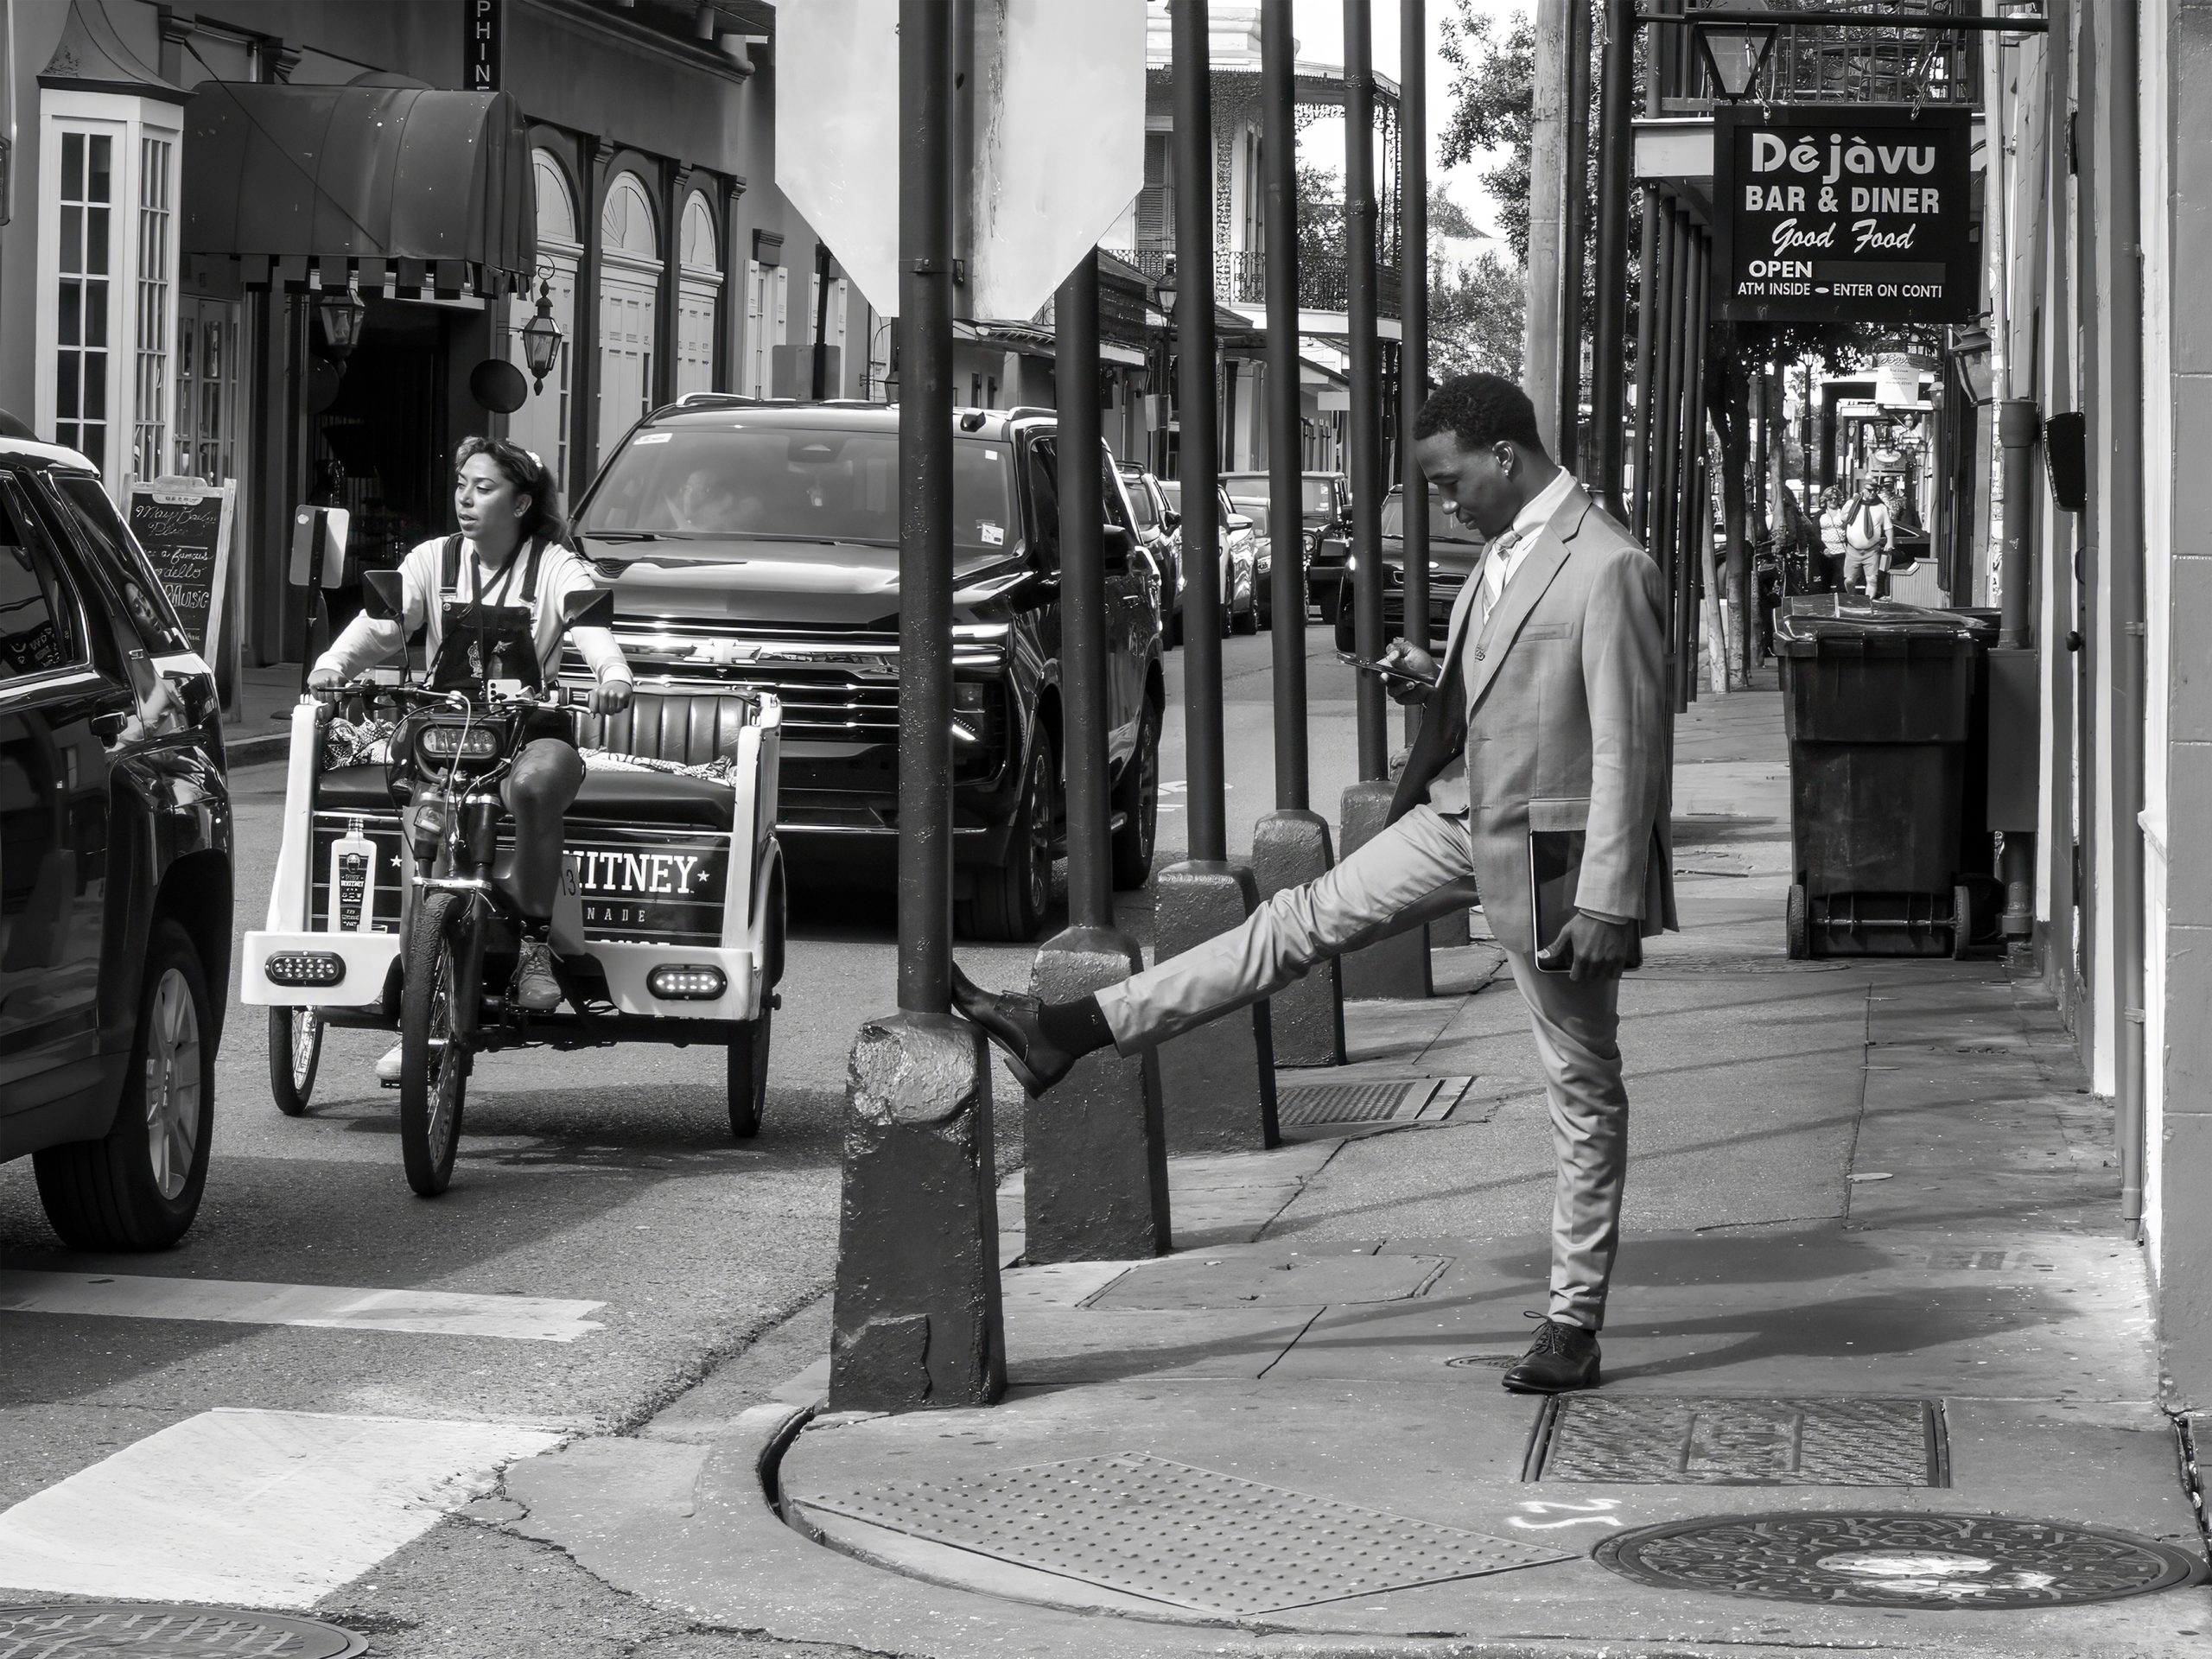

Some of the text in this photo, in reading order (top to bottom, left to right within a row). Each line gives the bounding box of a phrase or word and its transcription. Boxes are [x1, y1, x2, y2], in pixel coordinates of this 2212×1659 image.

[475, 0, 491, 90] PHIN
[1745, 185, 1940, 213] BAR & DINER
[1771, 218, 1916, 257] Good Food
[1748, 260, 1813, 278] OPEN
[1738, 282, 1942, 298] ATM INSIDE ENTER ON CONTI
